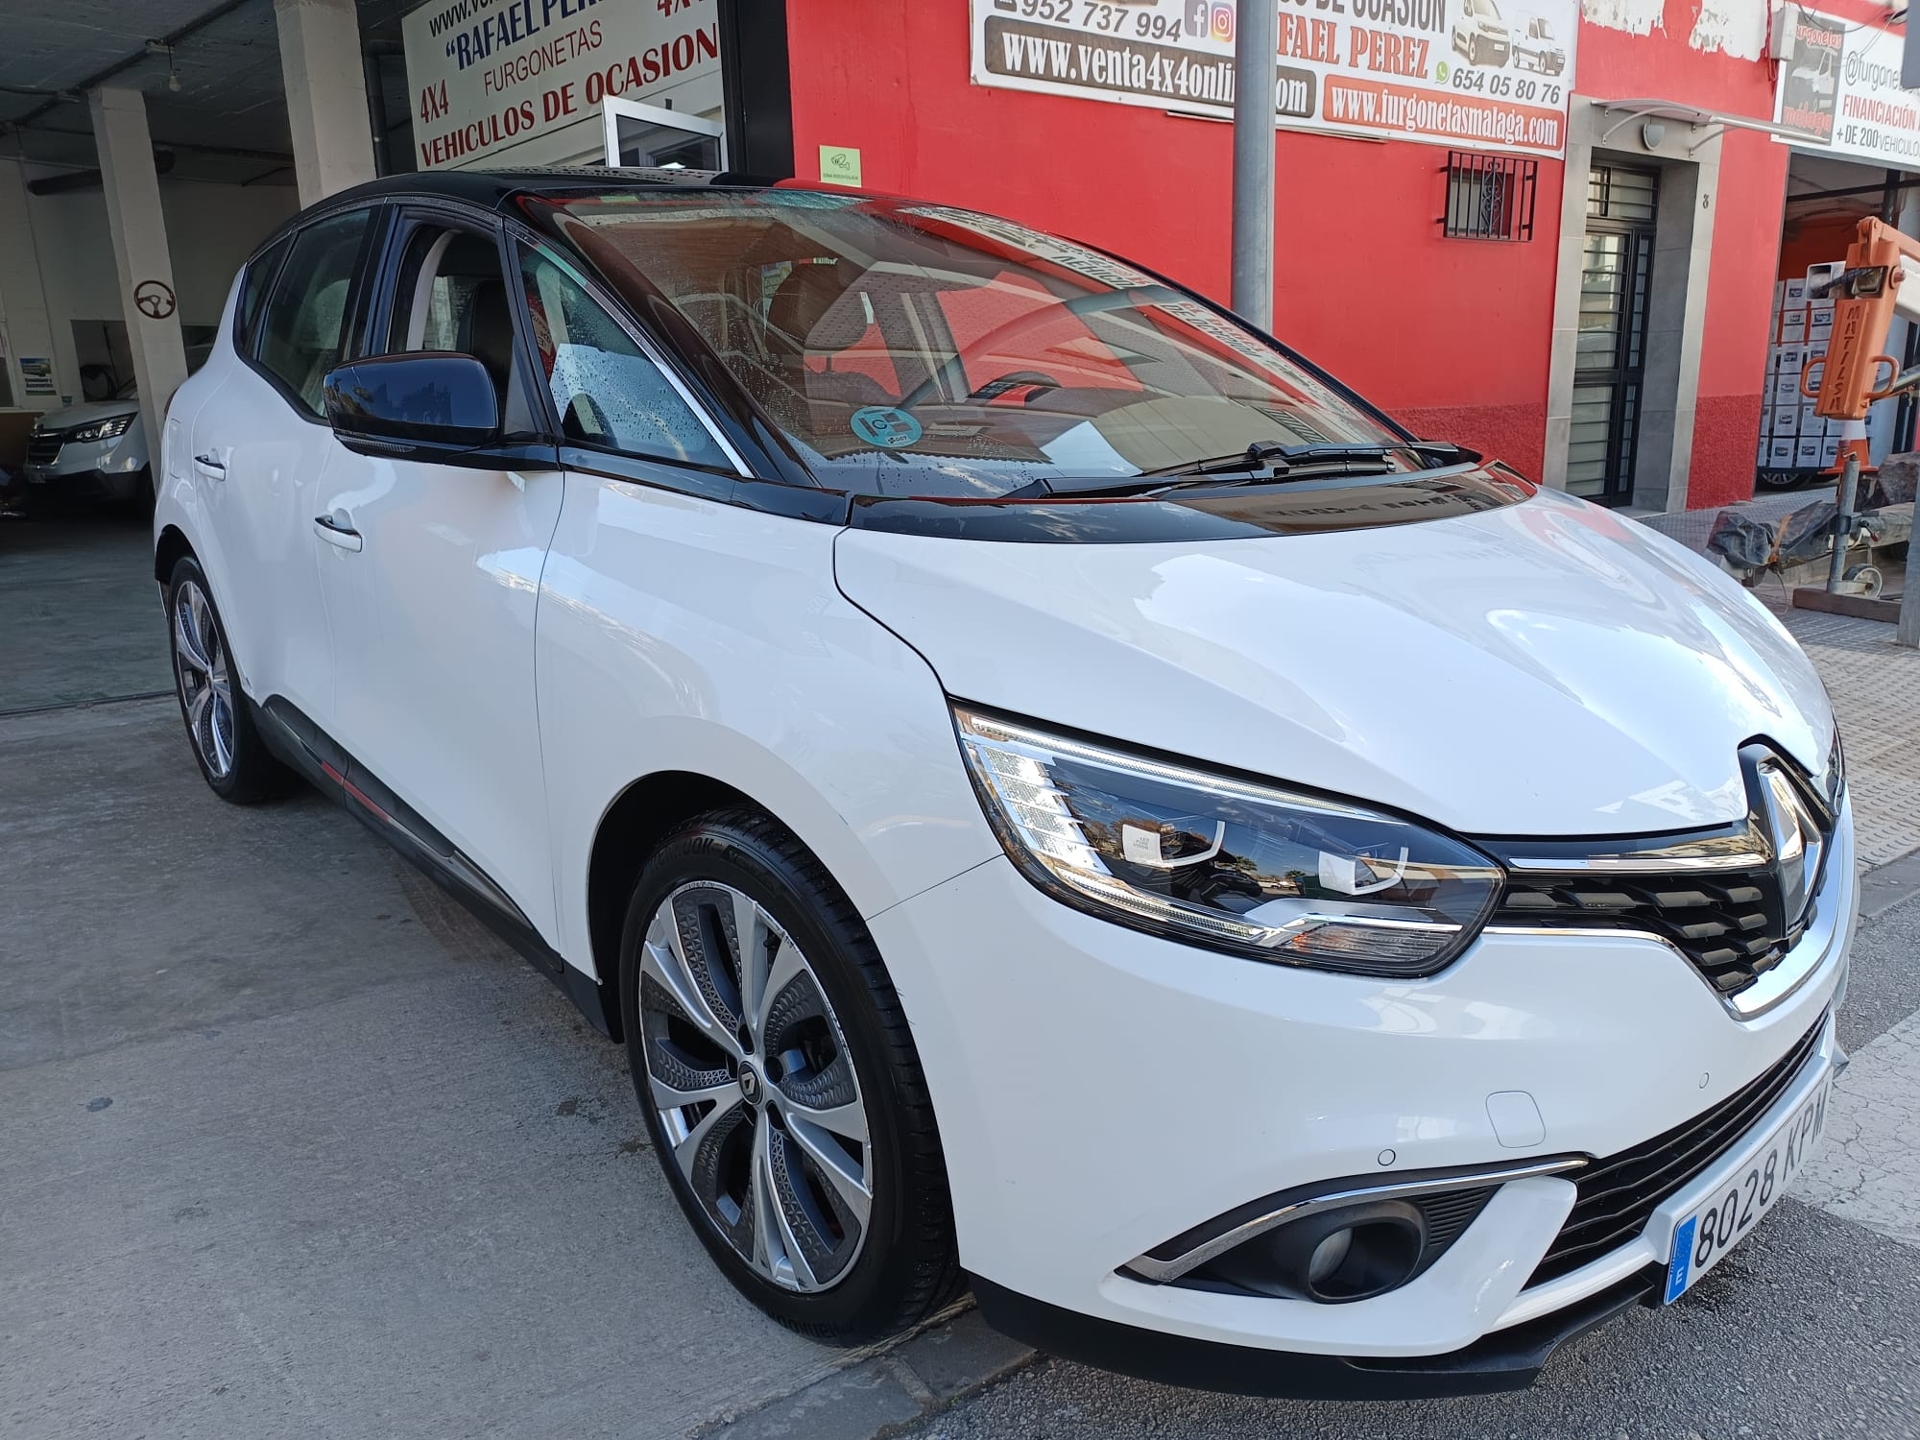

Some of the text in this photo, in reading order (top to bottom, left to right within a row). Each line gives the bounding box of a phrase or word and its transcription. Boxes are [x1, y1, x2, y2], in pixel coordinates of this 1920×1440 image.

[1021, 0, 1182, 42] 952 737 994
[1277, 12, 1430, 79] FAEL PEREZ
[1796, 22, 1842, 49] urgonetas
[420, 20, 603, 124] 4X4 FURGONETAS
[421, 23, 719, 168] VEHICULOS DE OCASION
[1452, 67, 1561, 105] 654 05 80 76
[1331, 86, 1558, 146] www.furgonetasmalaga.com
[1842, 93, 1917, 131] FINANCIACIÓN
[1844, 124, 1858, 145] DE
[1859, 127, 1879, 148] 200
[1878, 133, 1920, 157] VEHICULO
[1829, 305, 1860, 410] MATILSA
[1694, 1081, 1829, 1269] 8028 KPM
[1674, 1265, 1685, 1286] E
